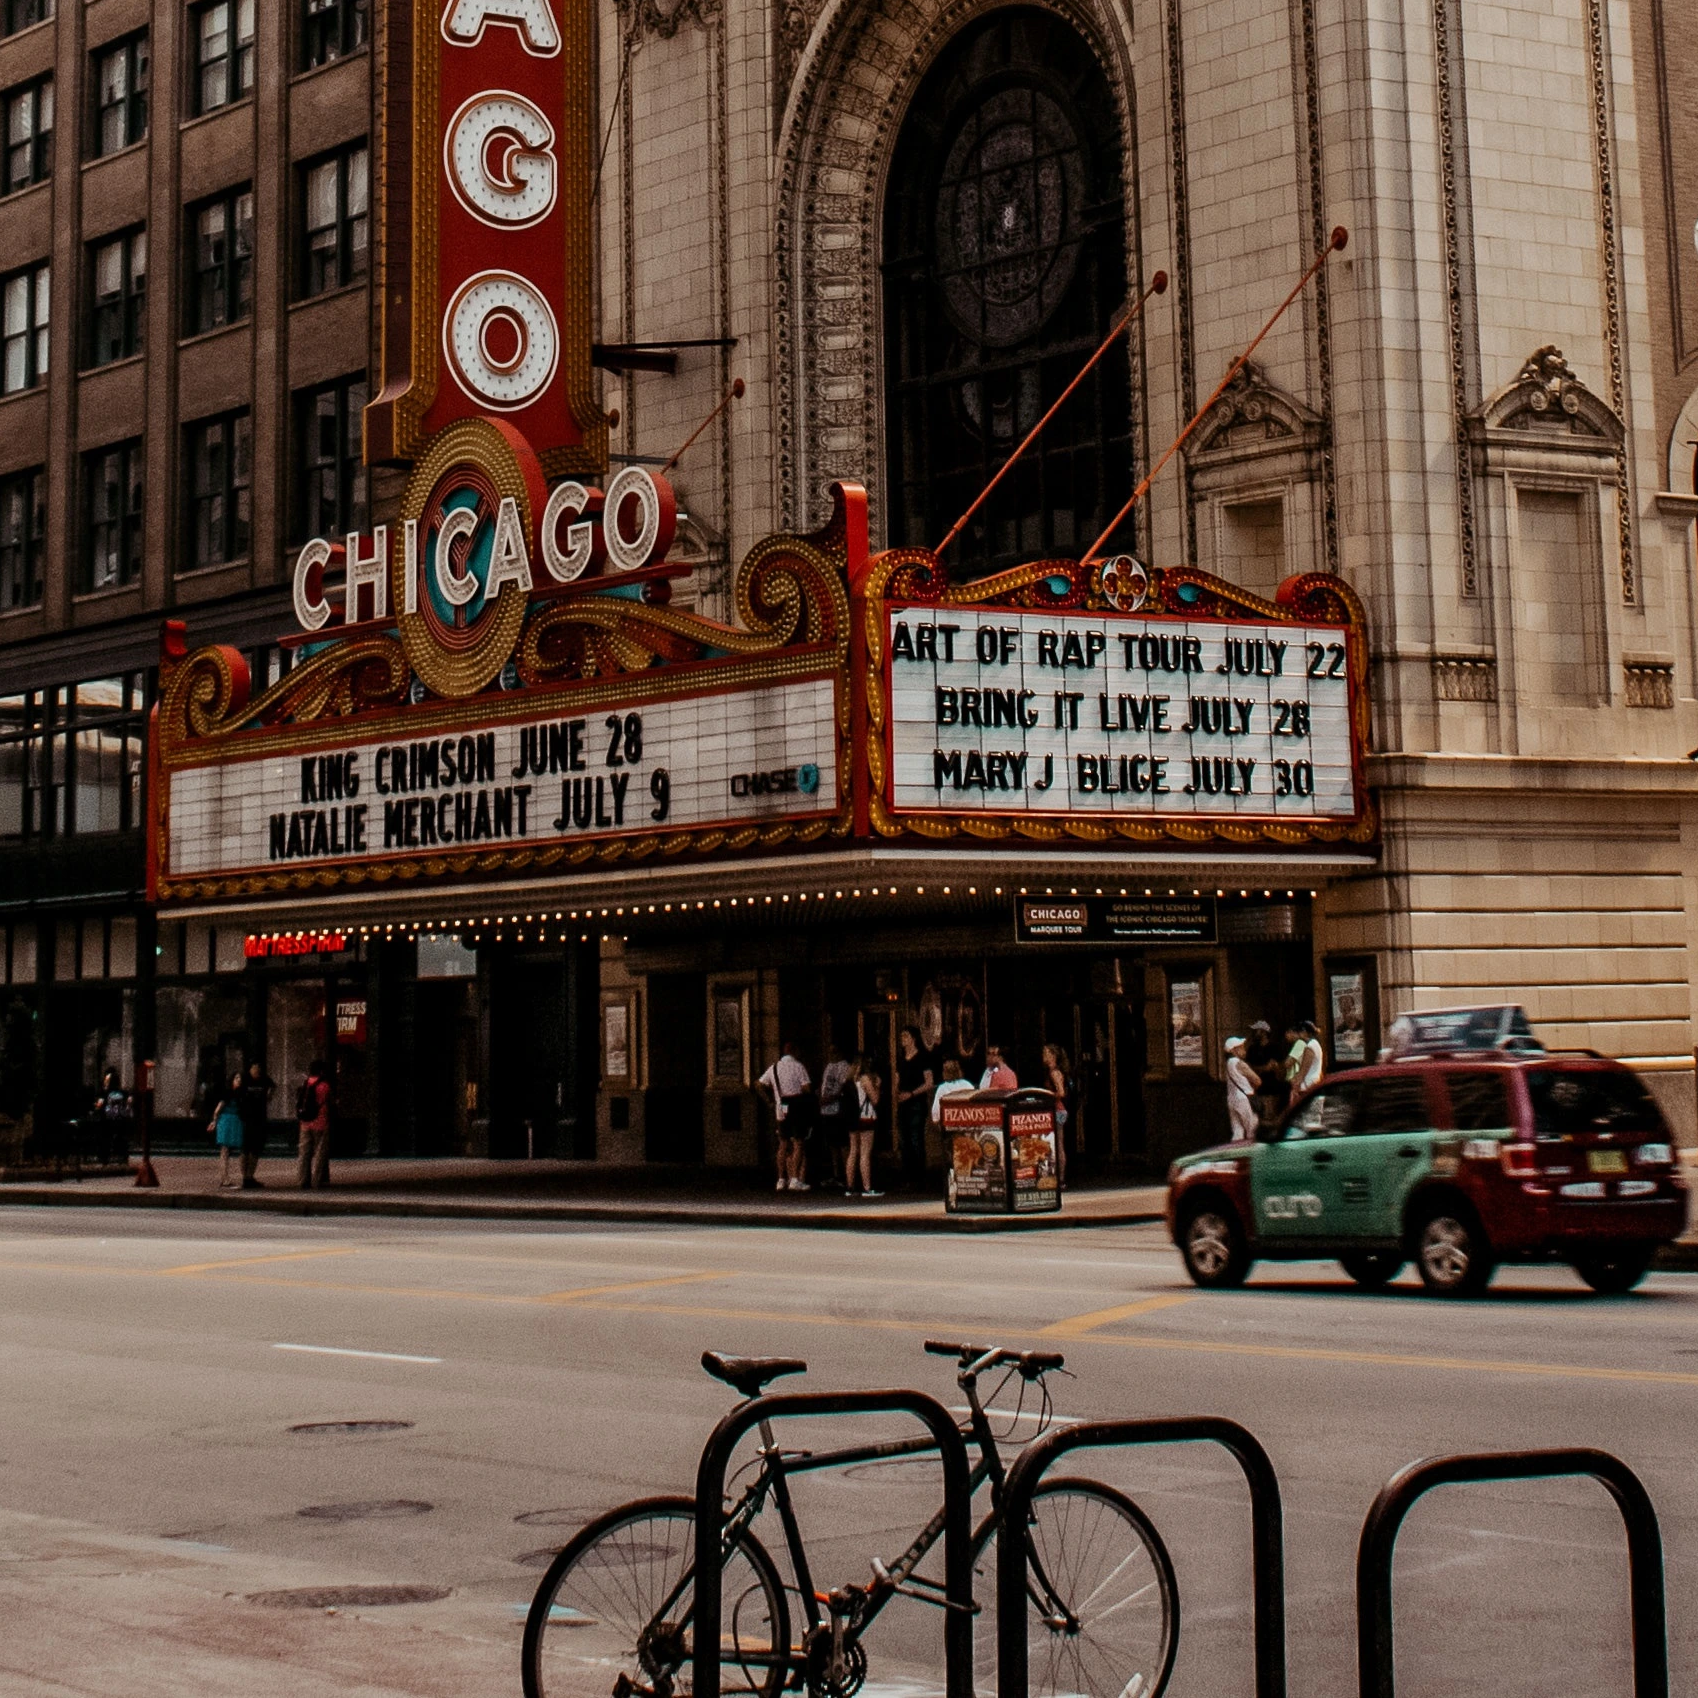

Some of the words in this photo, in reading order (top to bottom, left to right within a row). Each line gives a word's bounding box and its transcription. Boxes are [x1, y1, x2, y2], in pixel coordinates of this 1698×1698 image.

[293, 466, 661, 632] CHICAGO
[893, 621, 960, 663] ART
[976, 625, 1020, 665] OF
[1038, 628, 1106, 670] RAP
[1118, 632, 1203, 673] TOUR
[1217, 636, 1288, 677] JULY
[1307, 641, 1347, 679] 22
[936, 685, 1038, 729] BRING
[1054, 690, 1084, 730] IT
[1100, 692, 1172, 733] LIVE
[1182, 695, 1255, 736] JULY
[1273, 699, 1311, 737] 28
[301, 750, 361, 804] KING
[374, 732, 497, 795] CRIMSON
[512, 718, 587, 781] JUNE
[604, 712, 644, 768] 28
[933, 748, 1029, 791] MARY
[1035, 752, 1055, 791] J
[1077, 753, 1171, 795] BLIGE
[1184, 756, 1257, 796] JULY
[1275, 758, 1315, 797] 30
[730, 768, 798, 798] CHASE
[269, 803, 368, 861] NATALIE
[383, 785, 532, 850] MERCHANT
[553, 772, 630, 832] JULY
[650, 768, 671, 822] 9
[1030, 909, 1081, 920] CHICAGO
[1064, 926, 1083, 934] TOUR
[944, 1108, 985, 1122] PIZANO'S
[1011, 1113, 1052, 1125] PIZANO'S
